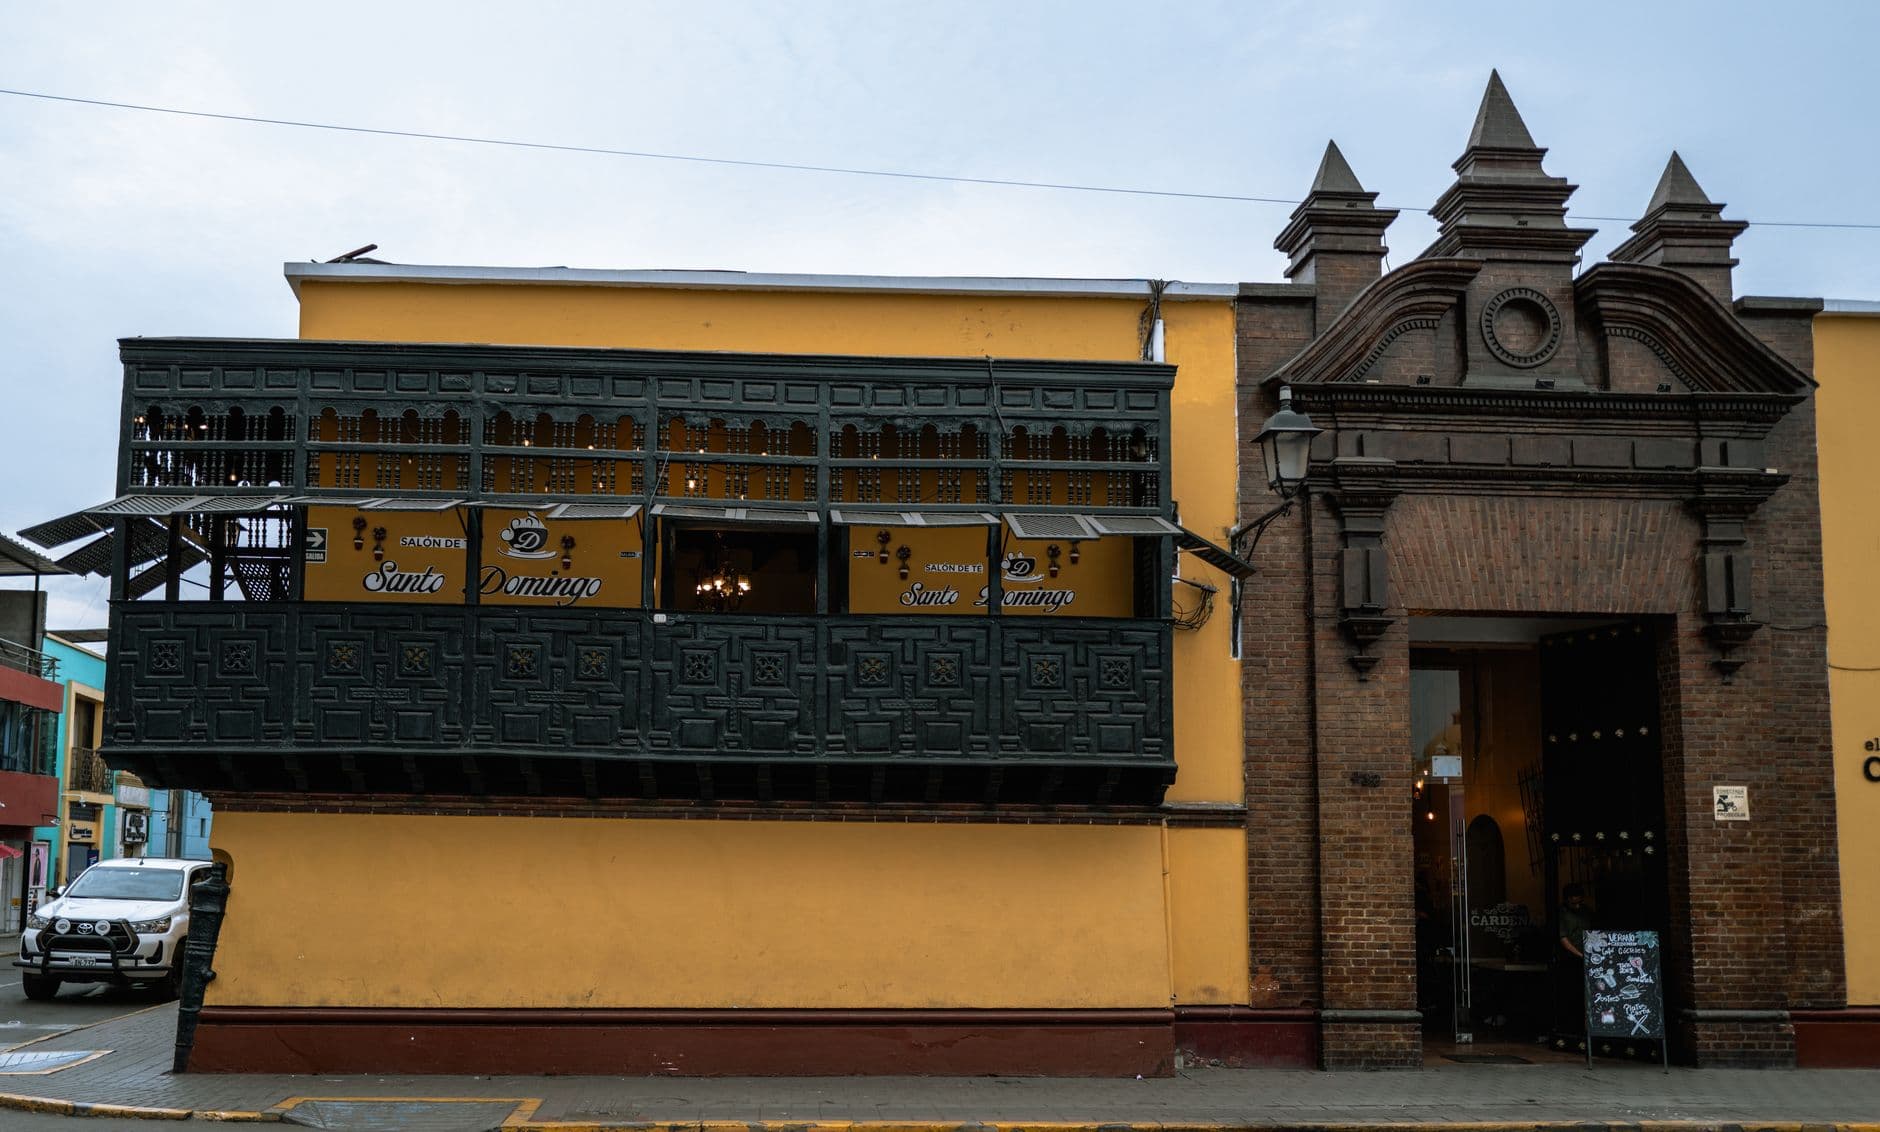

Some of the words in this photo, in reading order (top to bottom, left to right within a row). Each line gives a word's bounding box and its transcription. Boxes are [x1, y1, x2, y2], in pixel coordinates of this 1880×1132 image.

[401, 536, 441, 548] SALÓN
[445, 539, 461, 548] DE
[925, 562, 955, 572] SALÓN
[972, 563, 983, 573] TÉ
[362, 561, 446, 594] Santo
[900, 582, 959, 606] Santo
[1864, 737, 1880, 751] el
